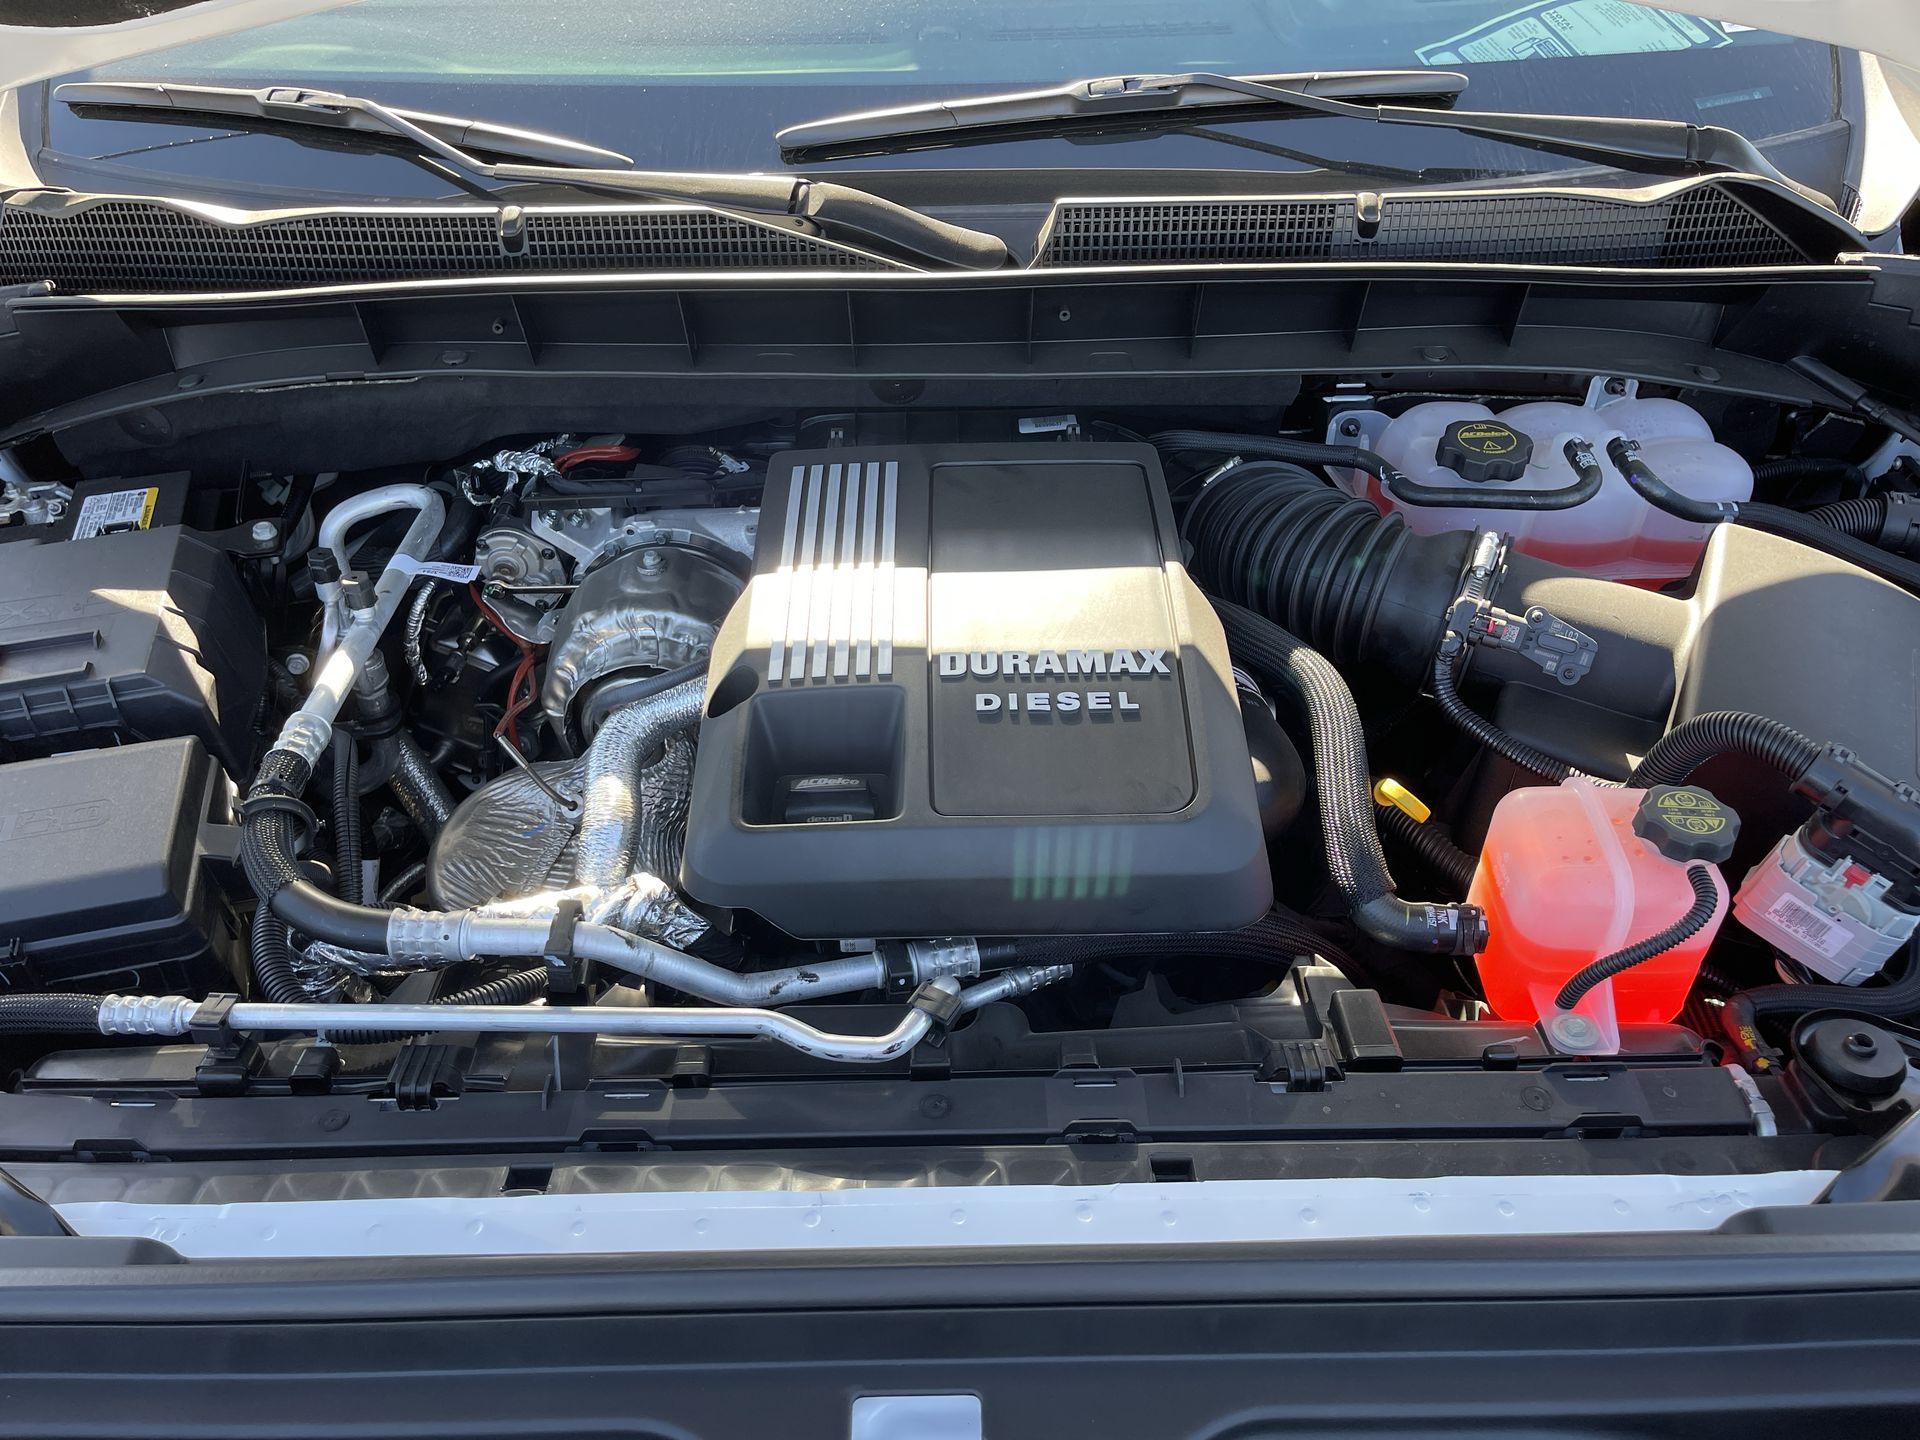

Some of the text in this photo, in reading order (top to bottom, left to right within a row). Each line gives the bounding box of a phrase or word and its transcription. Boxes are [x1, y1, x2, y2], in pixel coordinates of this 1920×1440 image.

[1545, 12, 1568, 31] PRICE
[1551, 10, 1574, 30] TOTAL
[1460, 431, 1509, 439] ACDelco
[939, 649, 1171, 677] DURAMAX
[975, 691, 1140, 711] DIESEL
[795, 777, 860, 789] ACDelco
